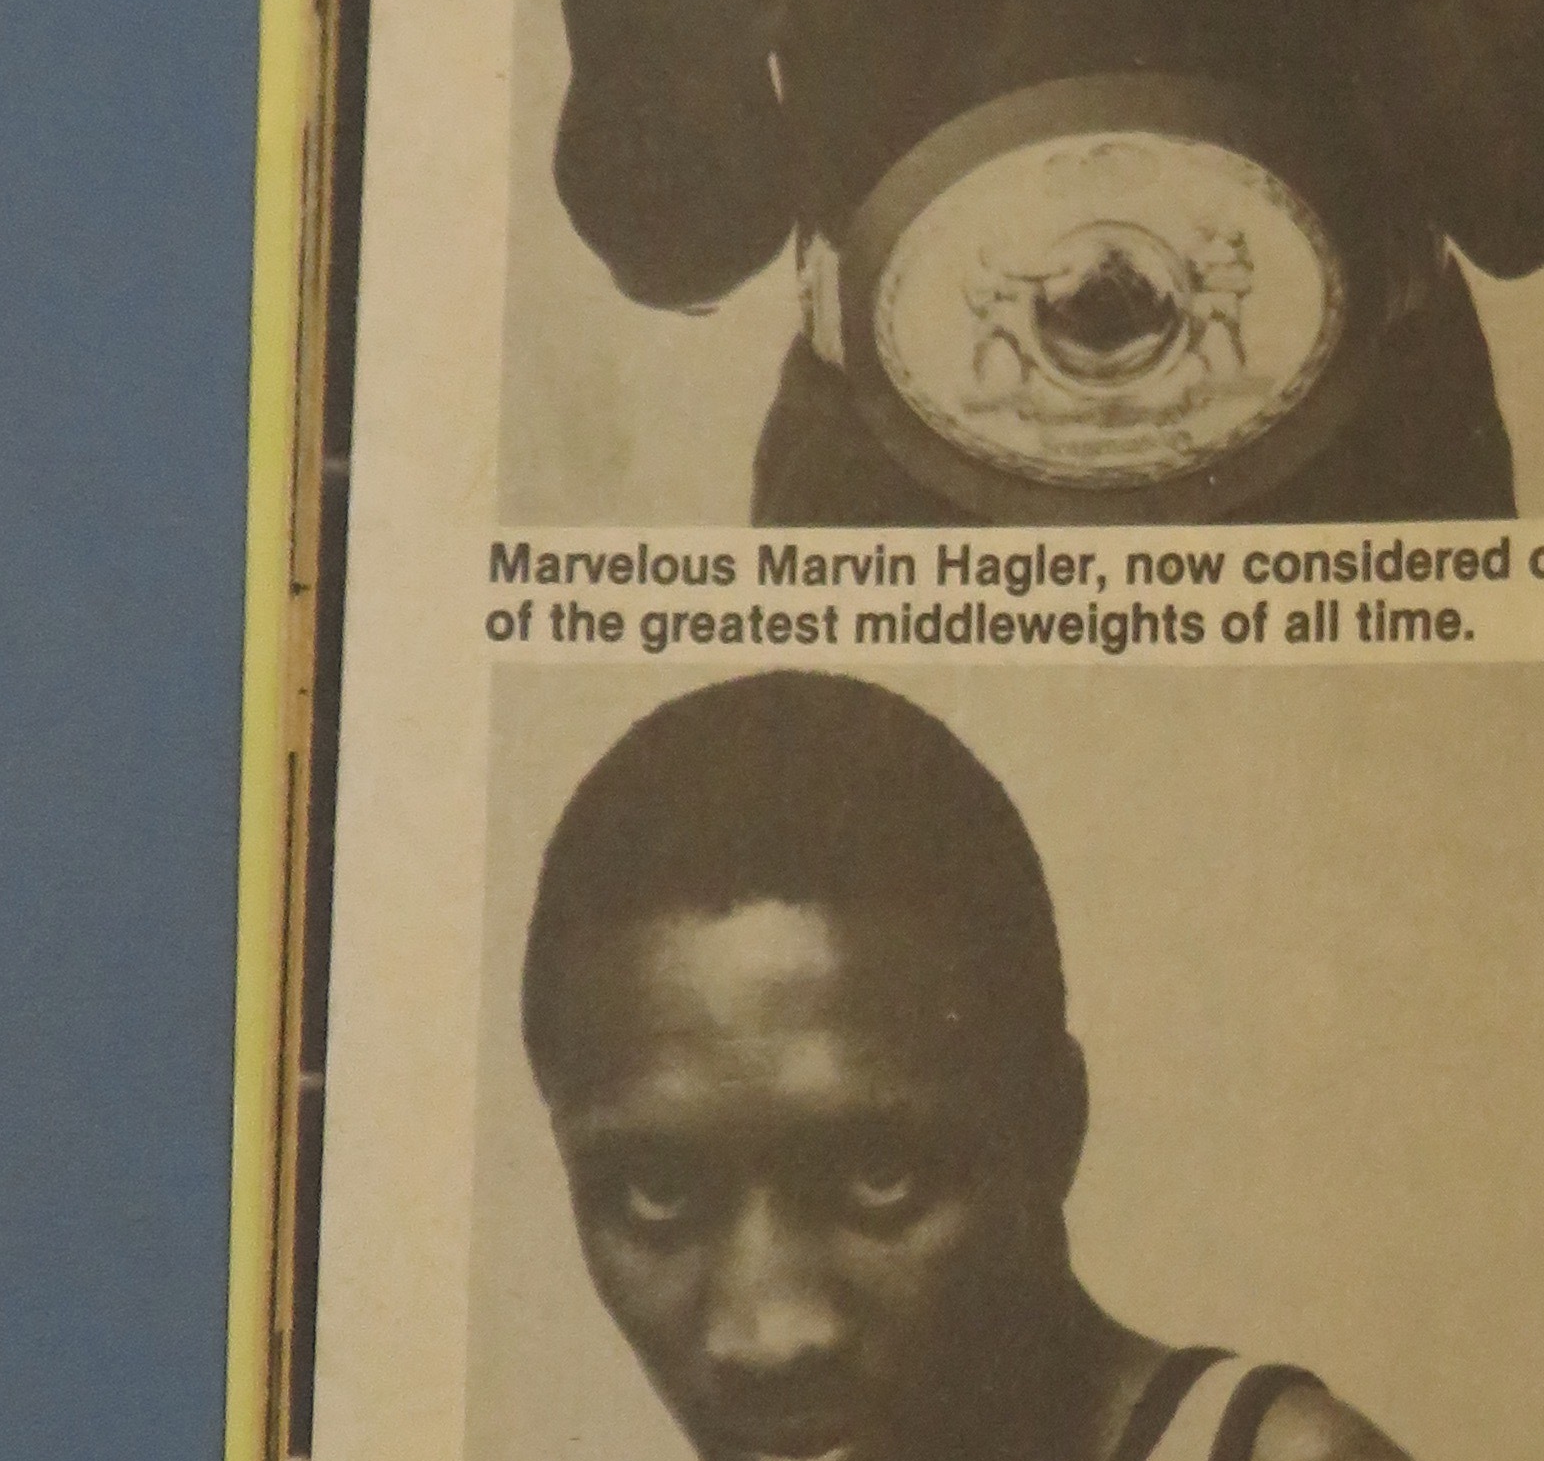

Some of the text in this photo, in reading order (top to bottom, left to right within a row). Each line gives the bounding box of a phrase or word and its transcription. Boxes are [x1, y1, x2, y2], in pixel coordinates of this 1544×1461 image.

[489, 541, 737, 587] Marvelous
[757, 543, 916, 587] Marvin
[937, 542, 1107, 597] Hagler,
[1126, 551, 1226, 587] now
[1242, 536, 1511, 585] considered
[485, 598, 1475, 656] of the greatest middleweights of all time.
